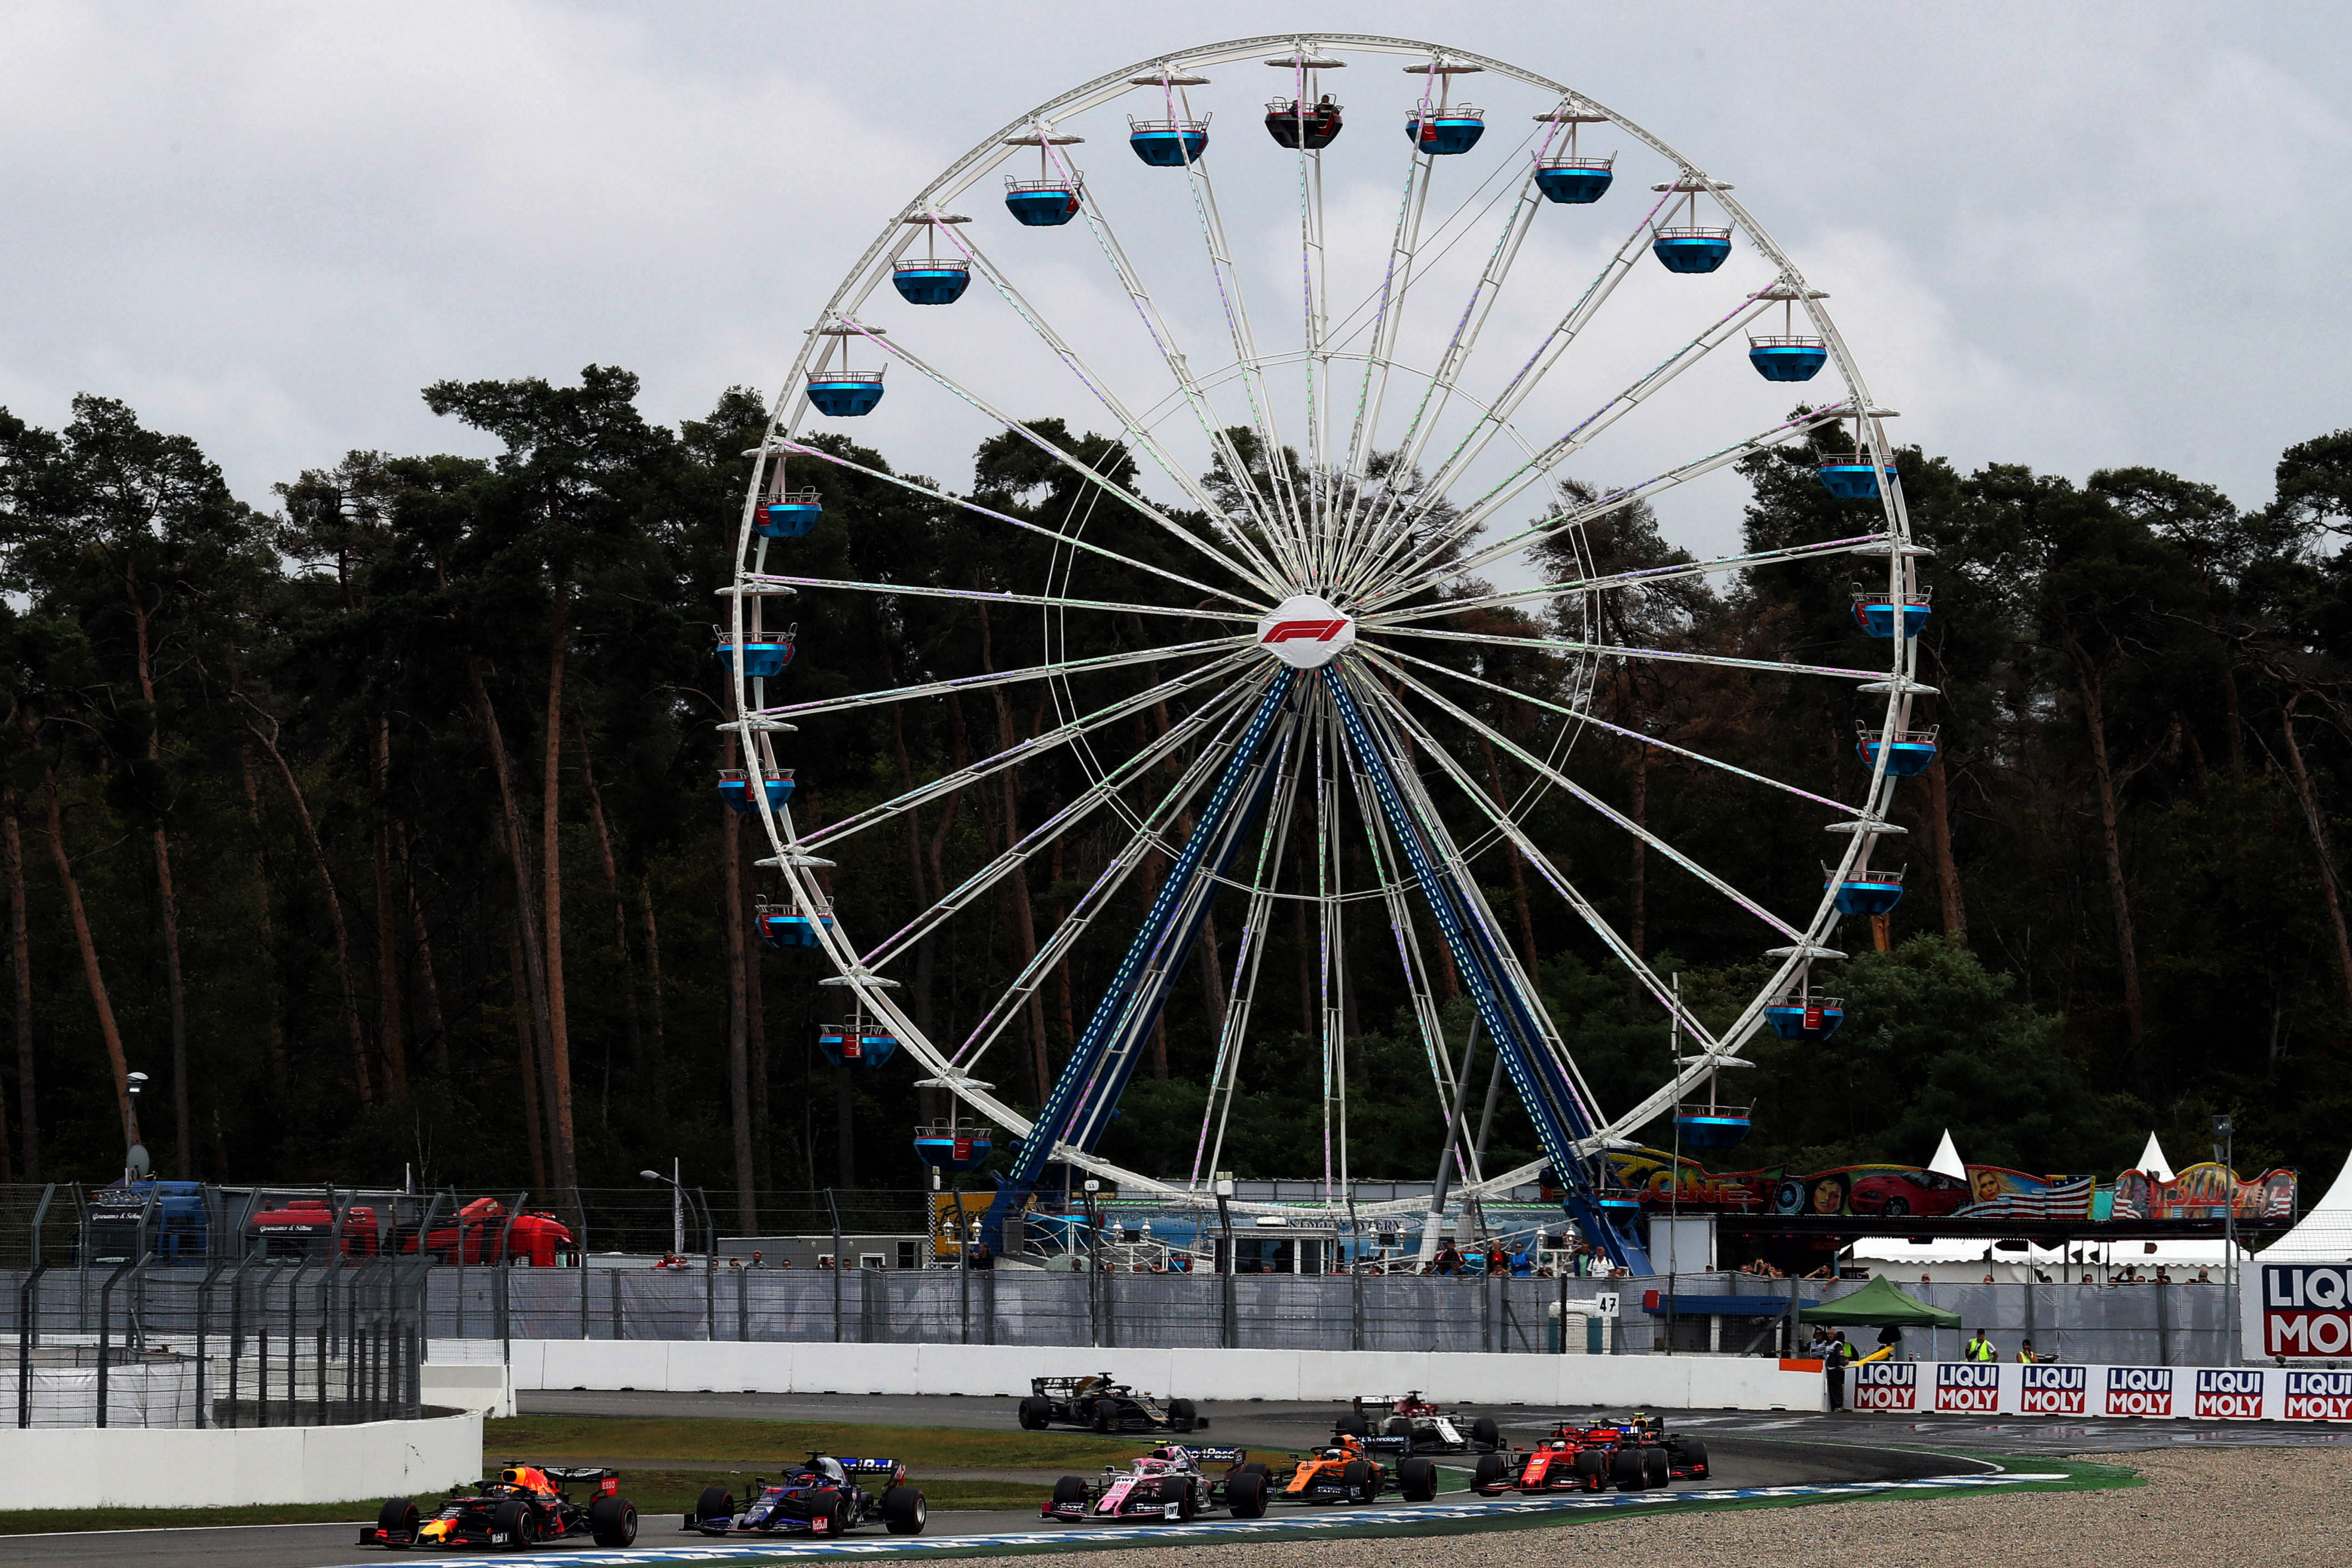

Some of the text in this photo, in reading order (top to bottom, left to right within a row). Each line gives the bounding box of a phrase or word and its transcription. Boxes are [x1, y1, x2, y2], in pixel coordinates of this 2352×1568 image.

[1260, 619, 1349, 643] F1
[2269, 1268, 2352, 1310] LIQ
[1600, 1297, 1616, 1312] 47
[2271, 1314, 2352, 1354] MO
[1858, 1365, 1914, 1386] LIQUI
[1939, 1365, 1997, 1387] LIQUI
[2025, 1367, 2082, 1389] LIQUI
[2110, 1369, 2169, 1391] LIQUI
[2199, 1372, 2260, 1393] LIQUI
[2289, 1374, 2351, 1396] LIQUI
[1856, 1387, 1915, 1408] MOLY
[1938, 1389, 1997, 1410] MOLY
[2024, 1391, 2084, 1412] MOLY
[2109, 1392, 2171, 1413] MOLY
[2198, 1395, 2262, 1415] MOLY
[2288, 1397, 2352, 1418] MOLY
[602, 1481, 615, 1489] ESSO
[492, 1533, 503, 1544] Mobil
